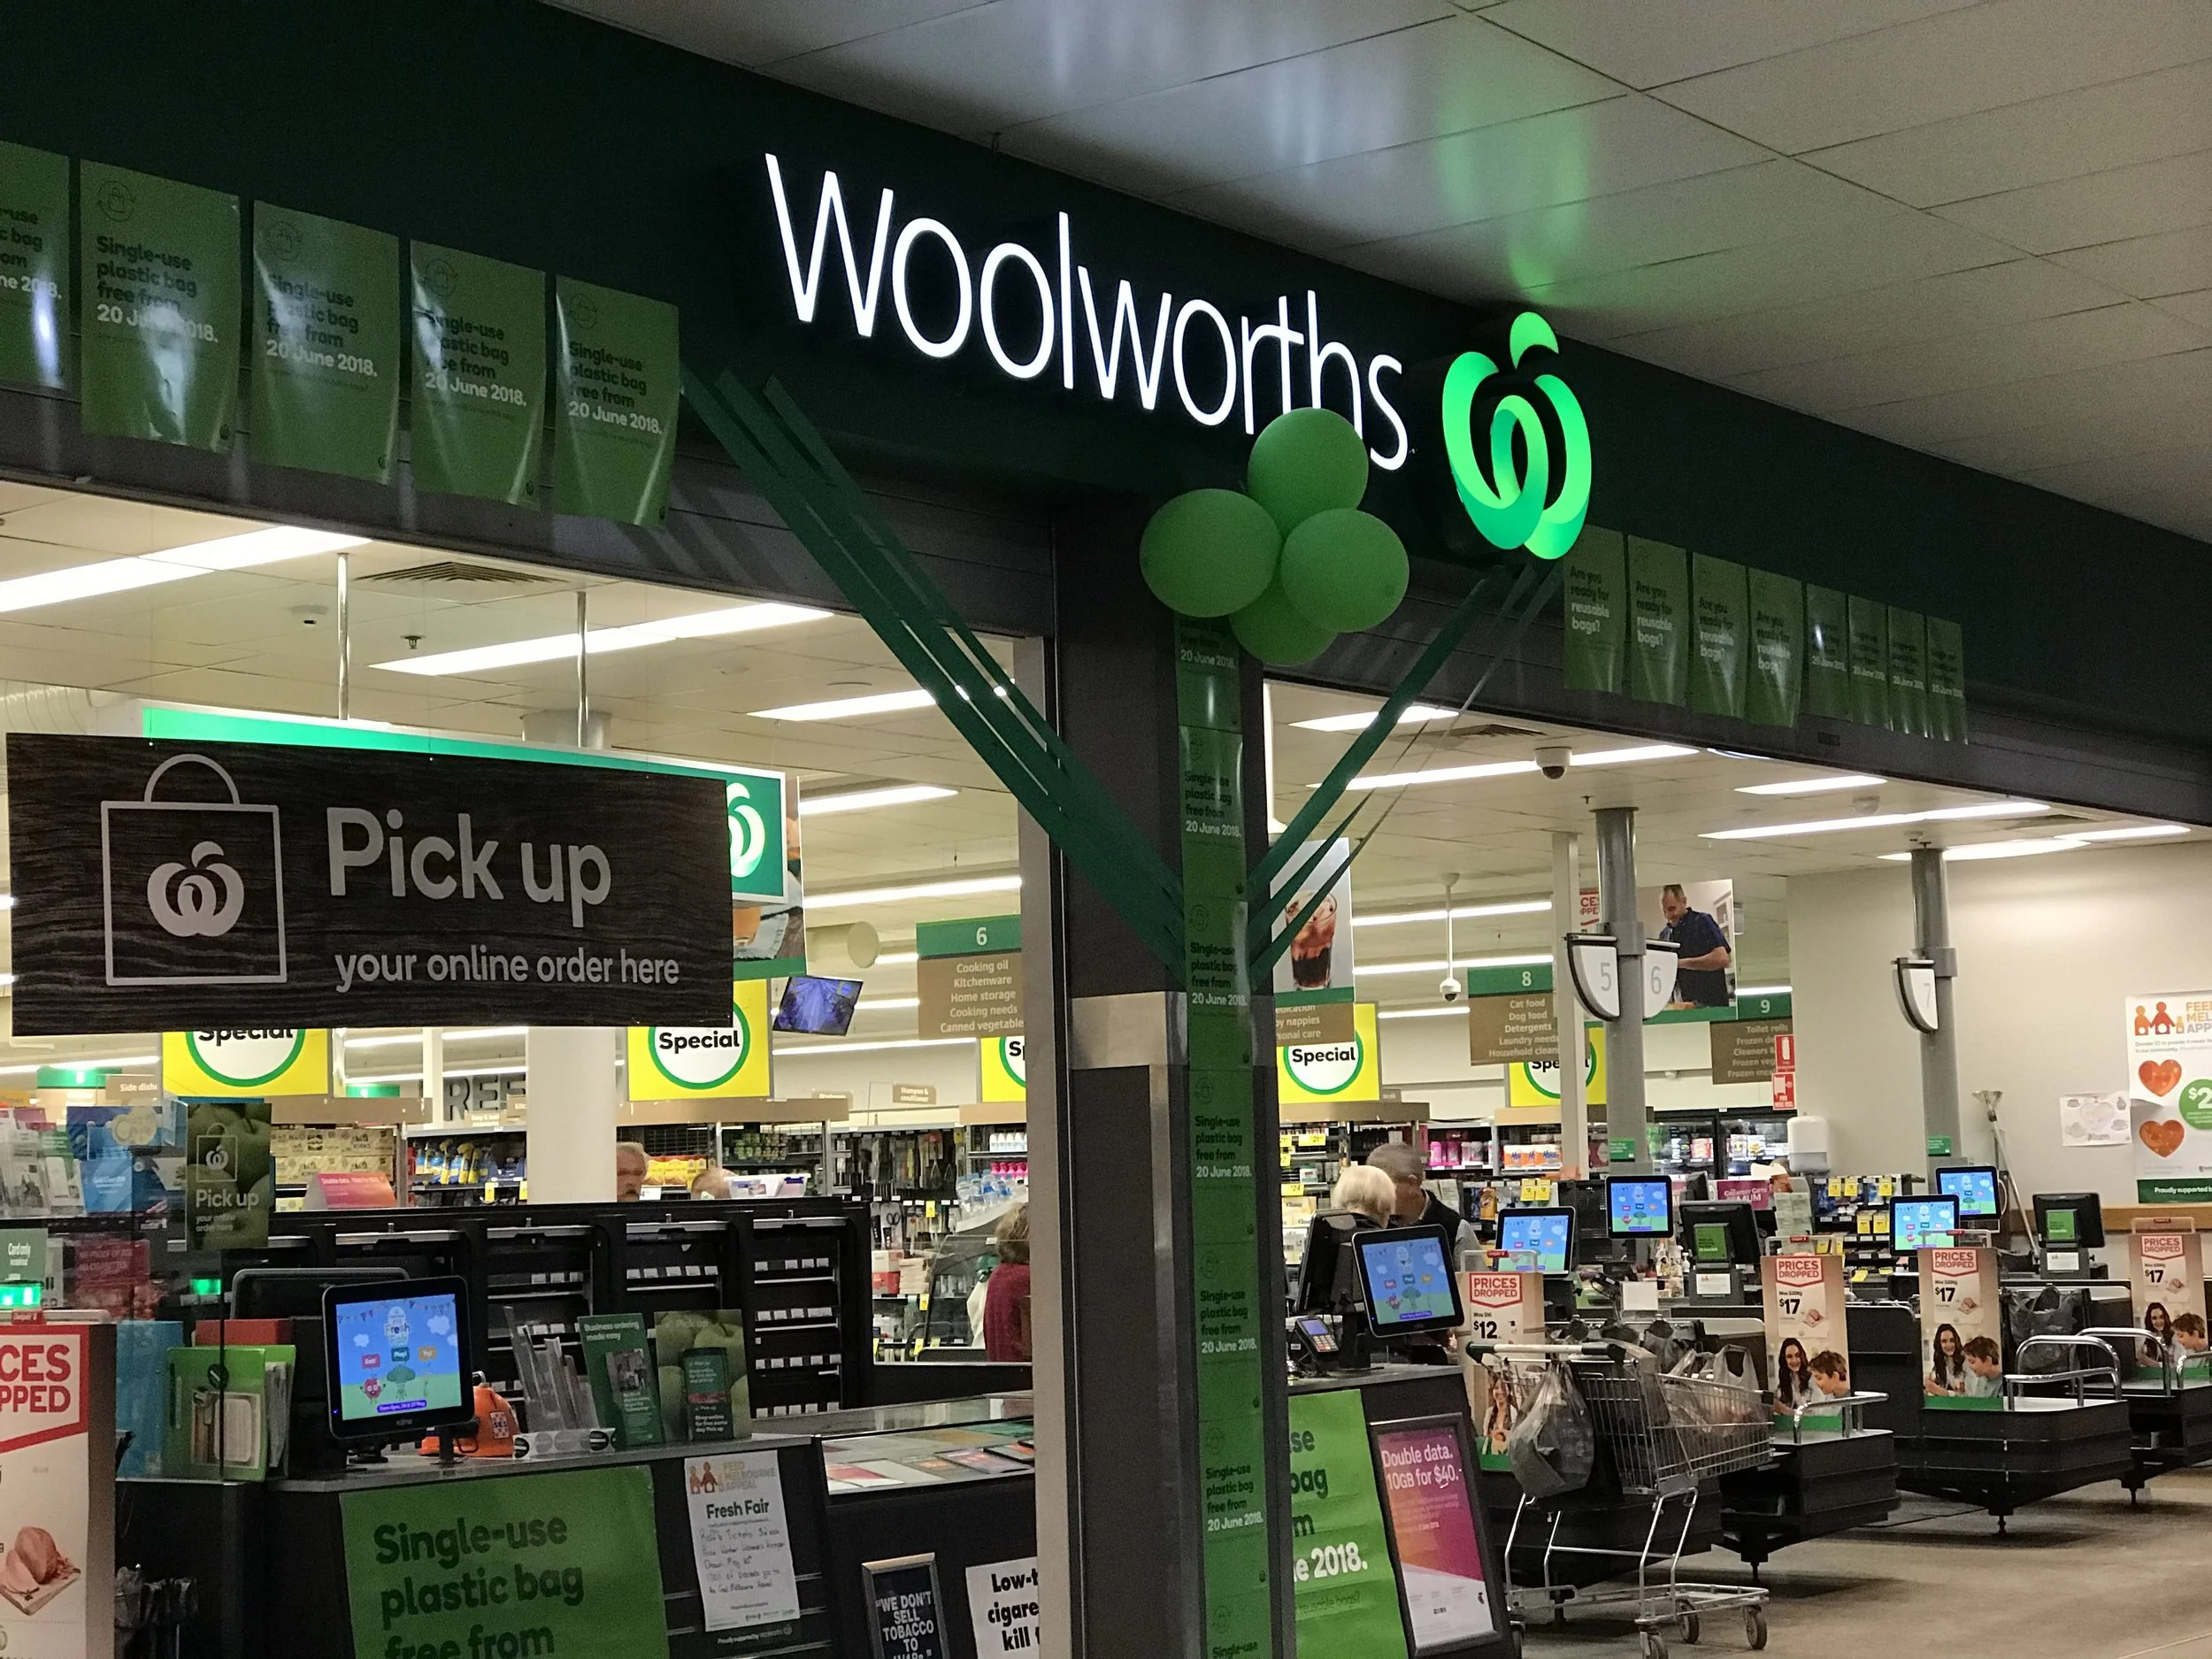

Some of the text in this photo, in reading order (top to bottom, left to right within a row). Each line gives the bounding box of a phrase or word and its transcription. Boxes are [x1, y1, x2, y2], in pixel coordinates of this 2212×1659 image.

[11, 227, 42, 253] bag
[96, 235, 192, 271] Single-use
[20, 275, 62, 300] 208.
[96, 261, 197, 298] plastic bag
[96, 280, 134, 303] free
[96, 303, 123, 324] 20
[764, 153, 1409, 471] Woolworths
[326, 309, 359, 334] bag
[305, 324, 344, 348] from
[266, 339, 379, 378] 20 June 2018.
[480, 344, 510, 367] bag
[569, 341, 643, 372] Single-use
[460, 357, 496, 380] from
[569, 364, 648, 396] plastic bag
[425, 371, 527, 408] 20 June 2018.
[602, 389, 635, 410] from
[568, 400, 664, 435] 20 June 2018.
[1571, 602, 1610, 619] reusable
[1571, 616, 1601, 635] bags?
[1636, 616, 1673, 631] reusable
[1700, 631, 1734, 648] reusable
[1180, 649, 1216, 665] 20 June
[1184, 789, 1215, 803] plastic
[1185, 803, 1204, 817] free
[1185, 819, 1221, 836] 20 June
[326, 806, 611, 928] Pick up
[976, 926, 987, 946] 6
[334, 944, 680, 994] your online order here
[956, 960, 1009, 974] Cooking oil
[1190, 960, 1222, 973] plastic
[954, 976, 1012, 988] Kitchenware
[1191, 976, 1232, 989] free from
[1521, 971, 1532, 987] 8
[1600, 962, 1612, 992] 5
[1650, 965, 1662, 995] 6
[950, 990, 1017, 1003] Home storage
[1191, 992, 1248, 1007] 20 June 2018.
[1509, 998, 1546, 1009] Cat food
[1923, 982, 1932, 1008] 7
[949, 1004, 1018, 1018] Cooking needs
[1760, 999, 1770, 1014] 9
[1286, 1016, 1320, 1027] nappies
[1509, 1010, 1548, 1022] Dog food
[940, 1021, 975, 1033] Canned
[1302, 1030, 1322, 1039] care
[1504, 1023, 1552, 1033] Detergents
[658, 1030, 741, 1054] Special
[1499, 1035, 1532, 1045] Laundry
[1292, 1047, 1356, 1066] Special
[1488, 1048, 1533, 1057] Household
[119, 1083, 137, 1092] Side
[1194, 1115, 1240, 1130] Single-use
[1195, 1133, 1243, 1148] plastic bag
[1195, 1148, 1236, 1161] free from
[1196, 1164, 1253, 1178] 20 June 2018.
[196, 1188, 259, 1211] Pick up
[196, 1215, 213, 1225] your
[1934, 1251, 1974, 1261] PRICES
[1778, 1260, 1818, 1271] PRICES
[1473, 1278, 1517, 1288] PRICES
[2145, 1269, 2164, 1283] $17
[1200, 1289, 1246, 1304] Single-use
[1473, 1288, 1517, 1297] DROPPED
[1935, 1286, 1955, 1302] $17
[1200, 1305, 1248, 1322] plastic bag
[1779, 1298, 1801, 1315] $17
[1201, 1323, 1241, 1336] free from
[1473, 1320, 1498, 1339] $12
[1201, 1337, 1257, 1354] 20 June 2018.
[0, 1344, 71, 1383] CES
[0, 1385, 71, 1414] PPED
[1381, 1442, 1454, 1469] Double data.
[1205, 1463, 1252, 1480] Single-use
[1386, 1464, 1459, 1491] 10GB for $40.
[1206, 1479, 1254, 1499] plastic bag
[706, 1498, 770, 1519] Fresh Fair
[1207, 1499, 1248, 1514] free from
[1207, 1511, 1263, 1532] 20 June 2018.
[373, 1516, 568, 1570] Single-use
[1310, 1541, 1368, 1579] 2018.
[991, 1568, 1038, 1593] Low-t
[380, 1563, 585, 1632] plastic bag
[901, 1591, 932, 1609] DON'T
[894, 1609, 920, 1625] SELL
[987, 1601, 1039, 1627] cigare
[882, 1619, 934, 1641] TOBACCO
[1002, 1626, 1031, 1651] kill
[384, 1624, 556, 1659] free from
[902, 1637, 918, 1653] TO
